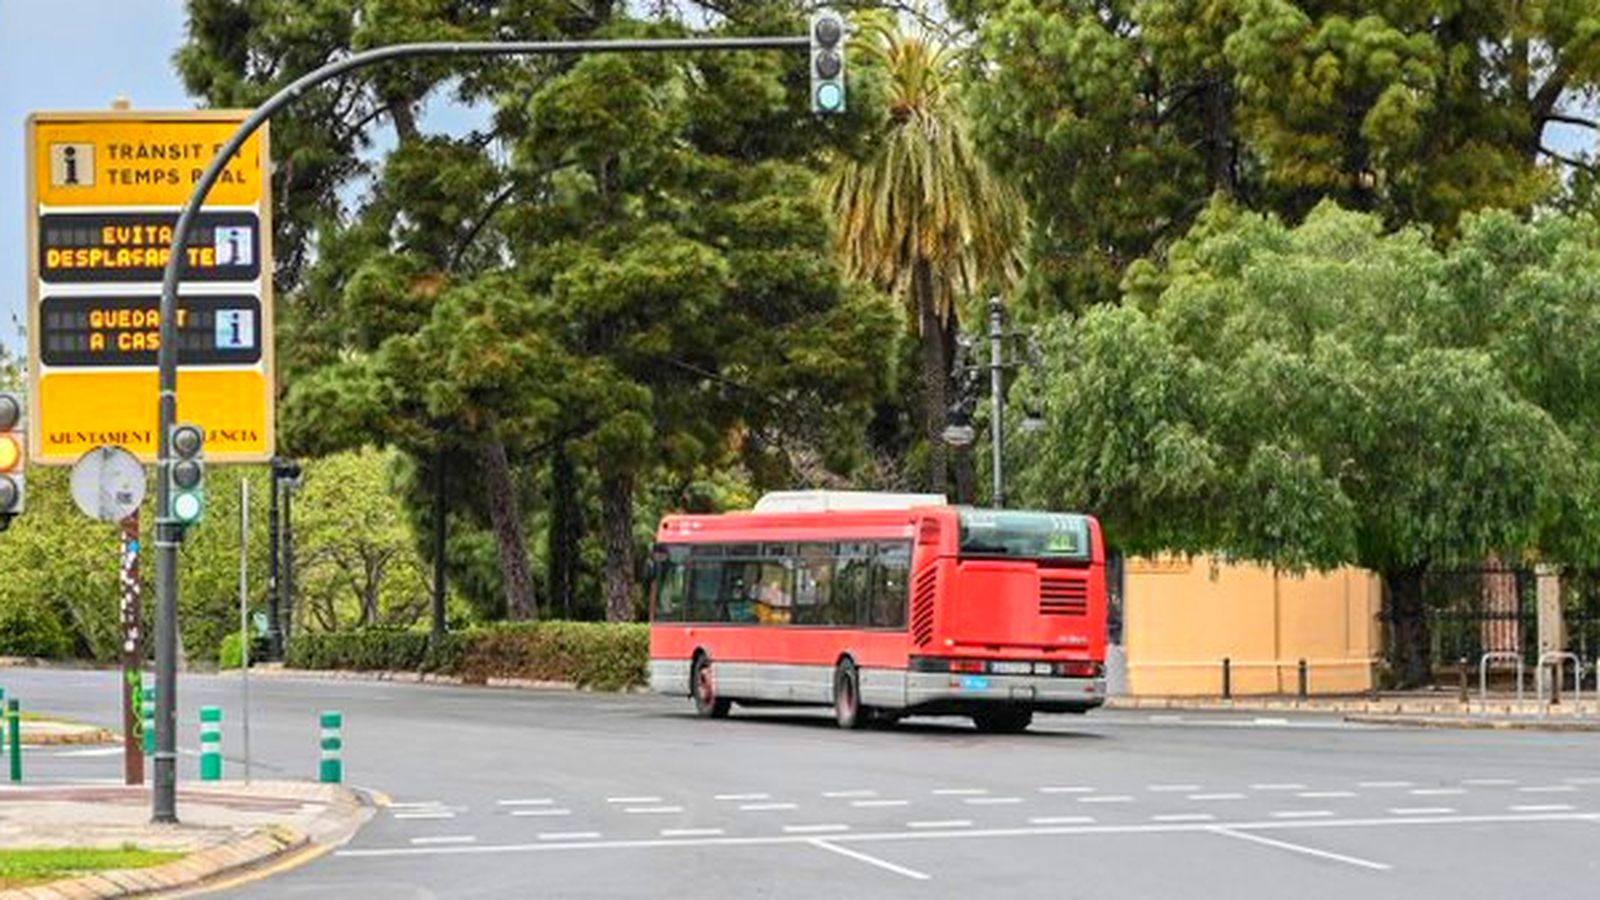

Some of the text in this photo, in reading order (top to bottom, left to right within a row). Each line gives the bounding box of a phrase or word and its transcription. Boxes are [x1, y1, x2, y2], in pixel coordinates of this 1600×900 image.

[107, 168, 246, 184] TEMPS RAL
[103, 226, 172, 244] EVITA
[89, 308, 187, 329] QUEDAT
[89, 332, 161, 351] A CAS
[49, 430, 151, 445] AJUNTAMENT
